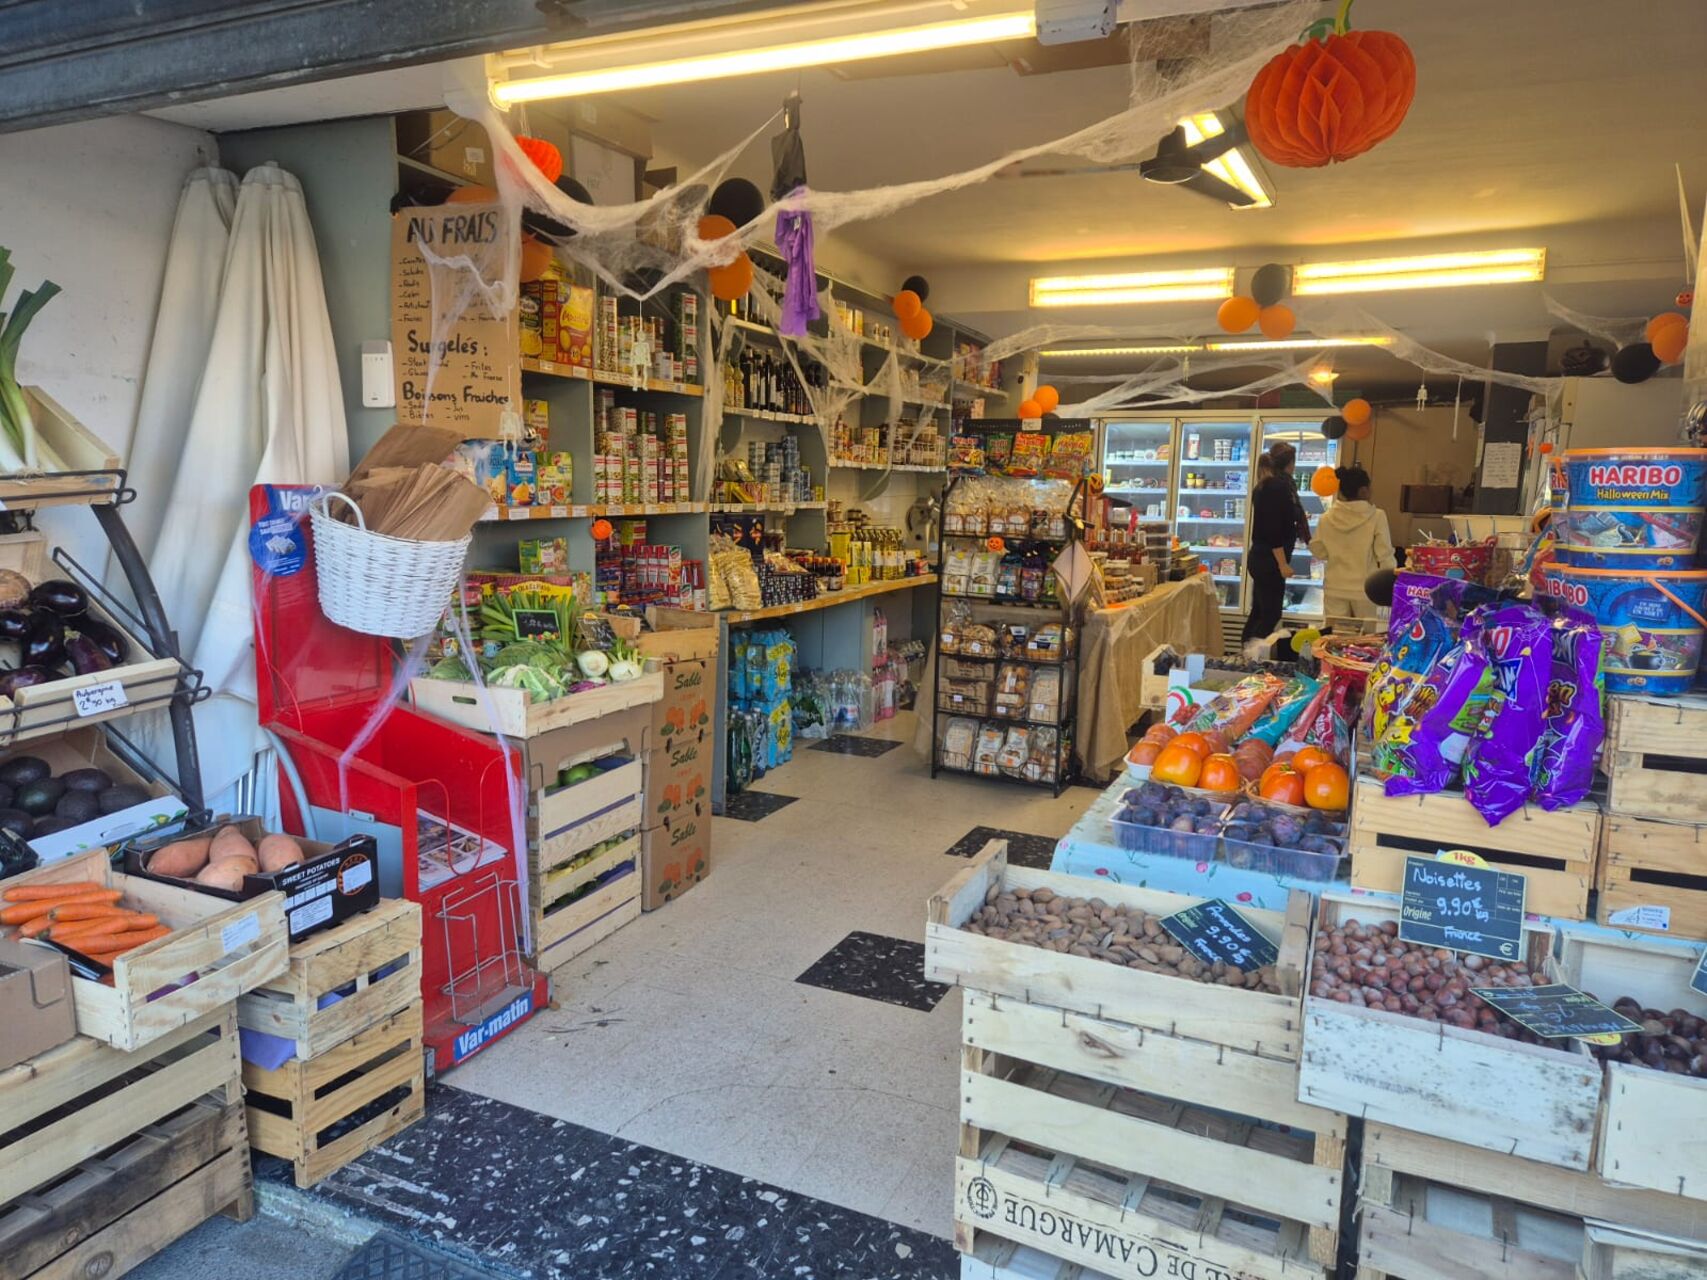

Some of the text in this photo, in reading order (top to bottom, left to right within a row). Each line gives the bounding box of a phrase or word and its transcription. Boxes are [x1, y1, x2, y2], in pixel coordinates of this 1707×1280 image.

[442, 211, 498, 244] FRAIS
[407, 329, 478, 360] Sugelés
[403, 381, 457, 402] Boisons
[1589, 465, 1682, 487] HARIBO
[279, 490, 310, 512] Var
[1597, 488, 1669, 500] Halloween Mix
[674, 672, 703, 691] Sable
[670, 746, 698, 768] Sable
[671, 821, 698, 847] Sable
[1453, 852, 1476, 866] 1kg
[281, 871, 306, 887] SWEET
[306, 857, 341, 876] POTATOES
[1413, 867, 1482, 892] Noisettes
[1403, 906, 1432, 920] Origine
[1444, 926, 1482, 941] France
[1500, 943, 1513, 956] €
[458, 998, 529, 1056] Var-matin
[1004, 1198, 1197, 1280] DE CAMARGUE
